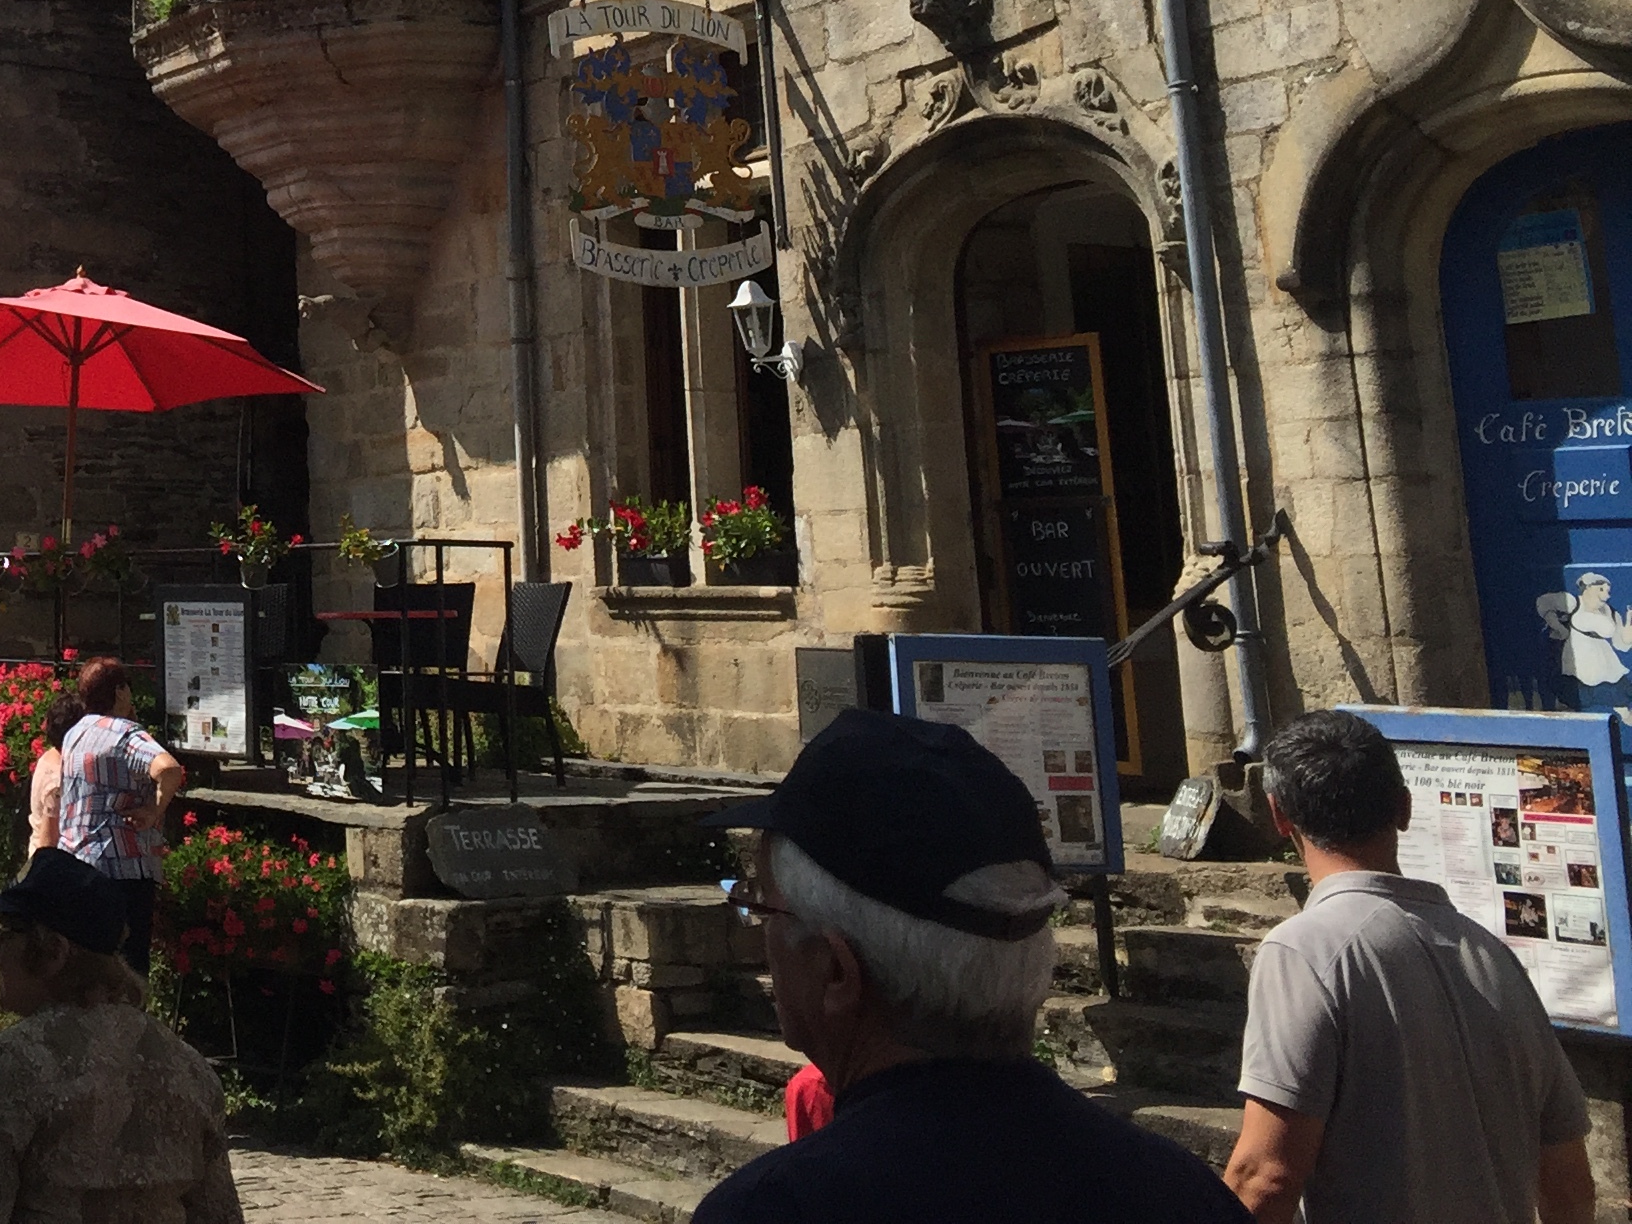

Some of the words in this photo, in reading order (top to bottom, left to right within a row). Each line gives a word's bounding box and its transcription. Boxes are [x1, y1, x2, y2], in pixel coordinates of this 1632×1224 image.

[564, 11, 593, 38] LA
[597, 4, 652, 29] TOUR
[660, 5, 681, 29] DU
[690, 9, 731, 41] LION
[653, 216, 684, 229] BAR
[1474, 412, 1548, 444] Café
[1517, 470, 1620, 508] Creperie
[1031, 520, 1069, 541] BAR
[24, 536, 32, 548] 2
[1016, 559, 1095, 579] OUVERT
[953, 668, 1000, 679] Bienvenue
[1438, 753, 1452, 761] au
[1455, 750, 1477, 764] Café
[1480, 751, 1516, 764] Breton
[1424, 763, 1439, 772] Bar
[1441, 765, 1465, 774] ouvert
[1467, 766, 1494, 776] depuis
[1414, 776, 1432, 787] 100
[1447, 778, 1462, 789] blé
[1464, 779, 1486, 790] noir
[443, 824, 543, 852] TERRASSE
